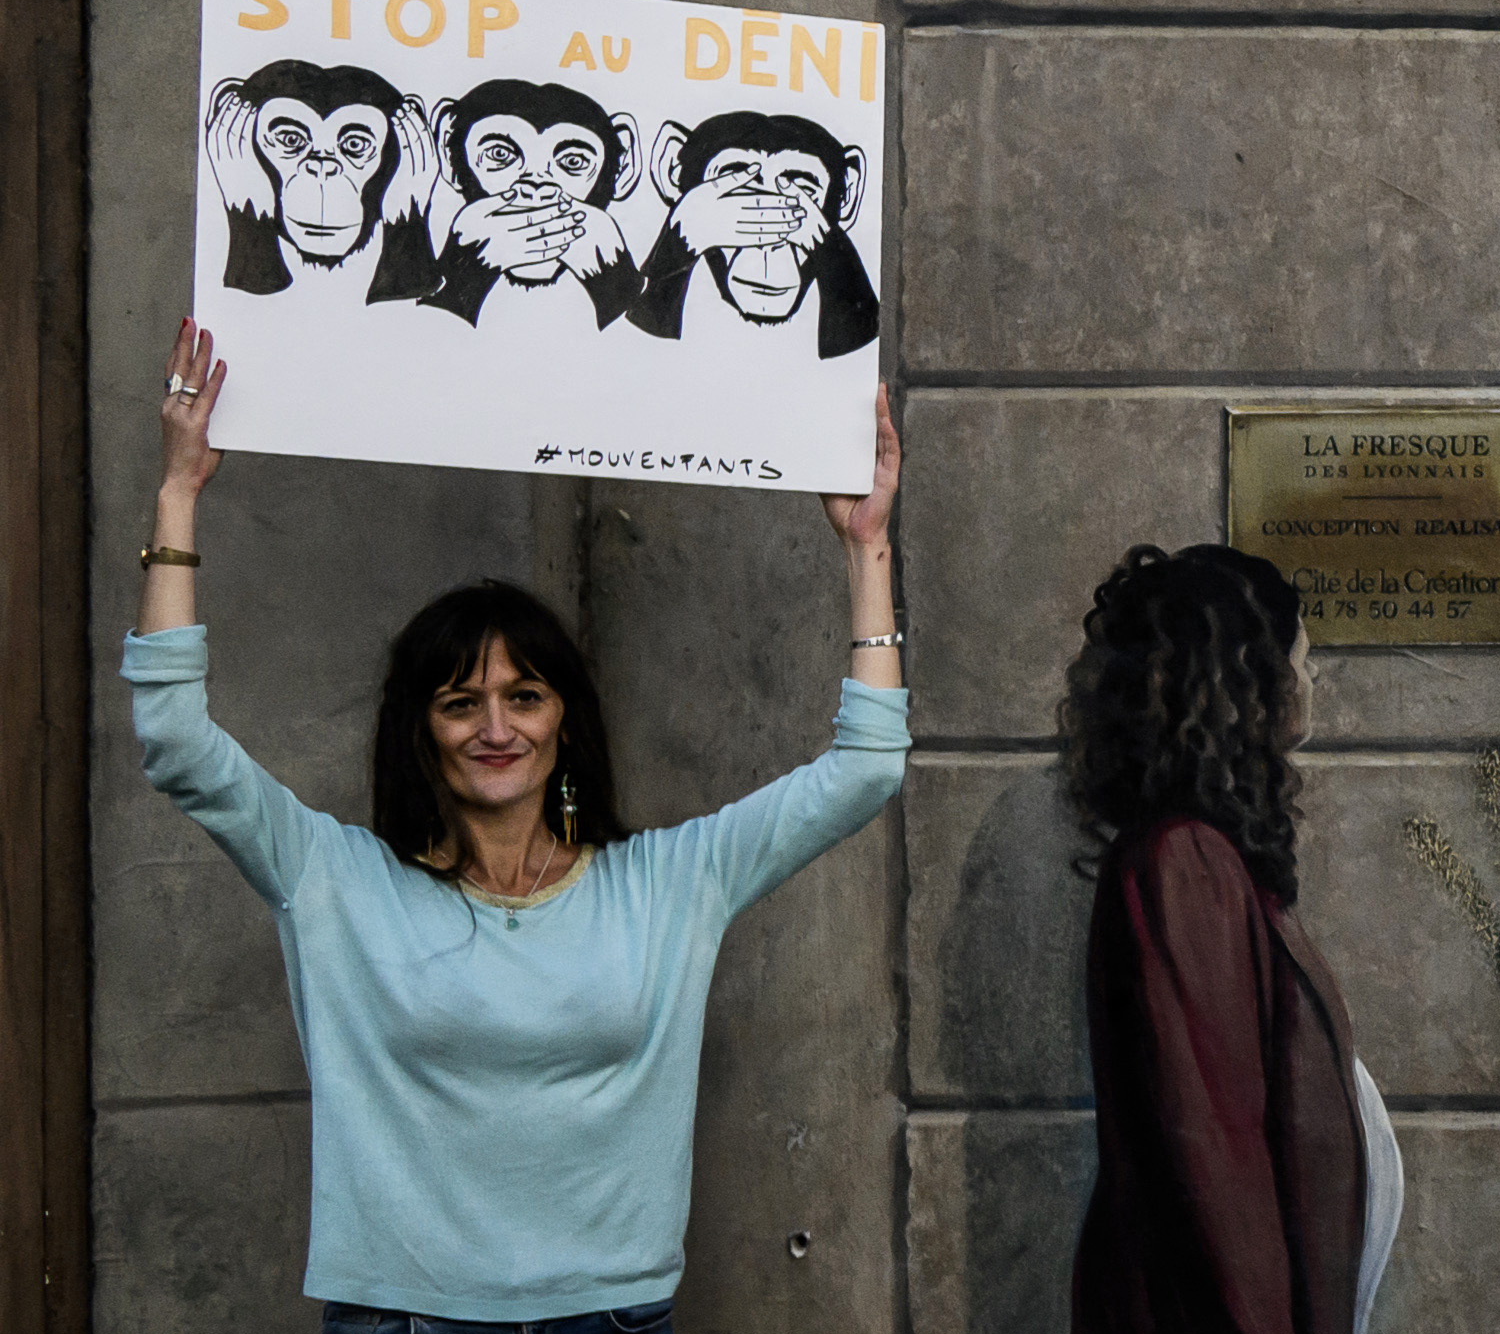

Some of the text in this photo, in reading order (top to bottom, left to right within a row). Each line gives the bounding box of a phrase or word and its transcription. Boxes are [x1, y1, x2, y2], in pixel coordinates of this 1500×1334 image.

[560, 32, 629, 72] AU
[685, 9, 875, 101] DÉNI
[1303, 435, 1490, 459] LA FRESQUE
[533, 443, 783, 480] #MOUVENFANTS
[1304, 464, 1485, 478] DES LYONNAIS
[1262, 519, 1400, 536] CONCEPTION
[1291, 570, 1341, 594] Cité
[1346, 569, 1375, 594] de
[1380, 569, 1399, 594] la
[1334, 601, 1358, 619] 78
[1369, 601, 1398, 619] 50
[1408, 601, 1434, 619] 44
[1448, 601, 1472, 619] 57
